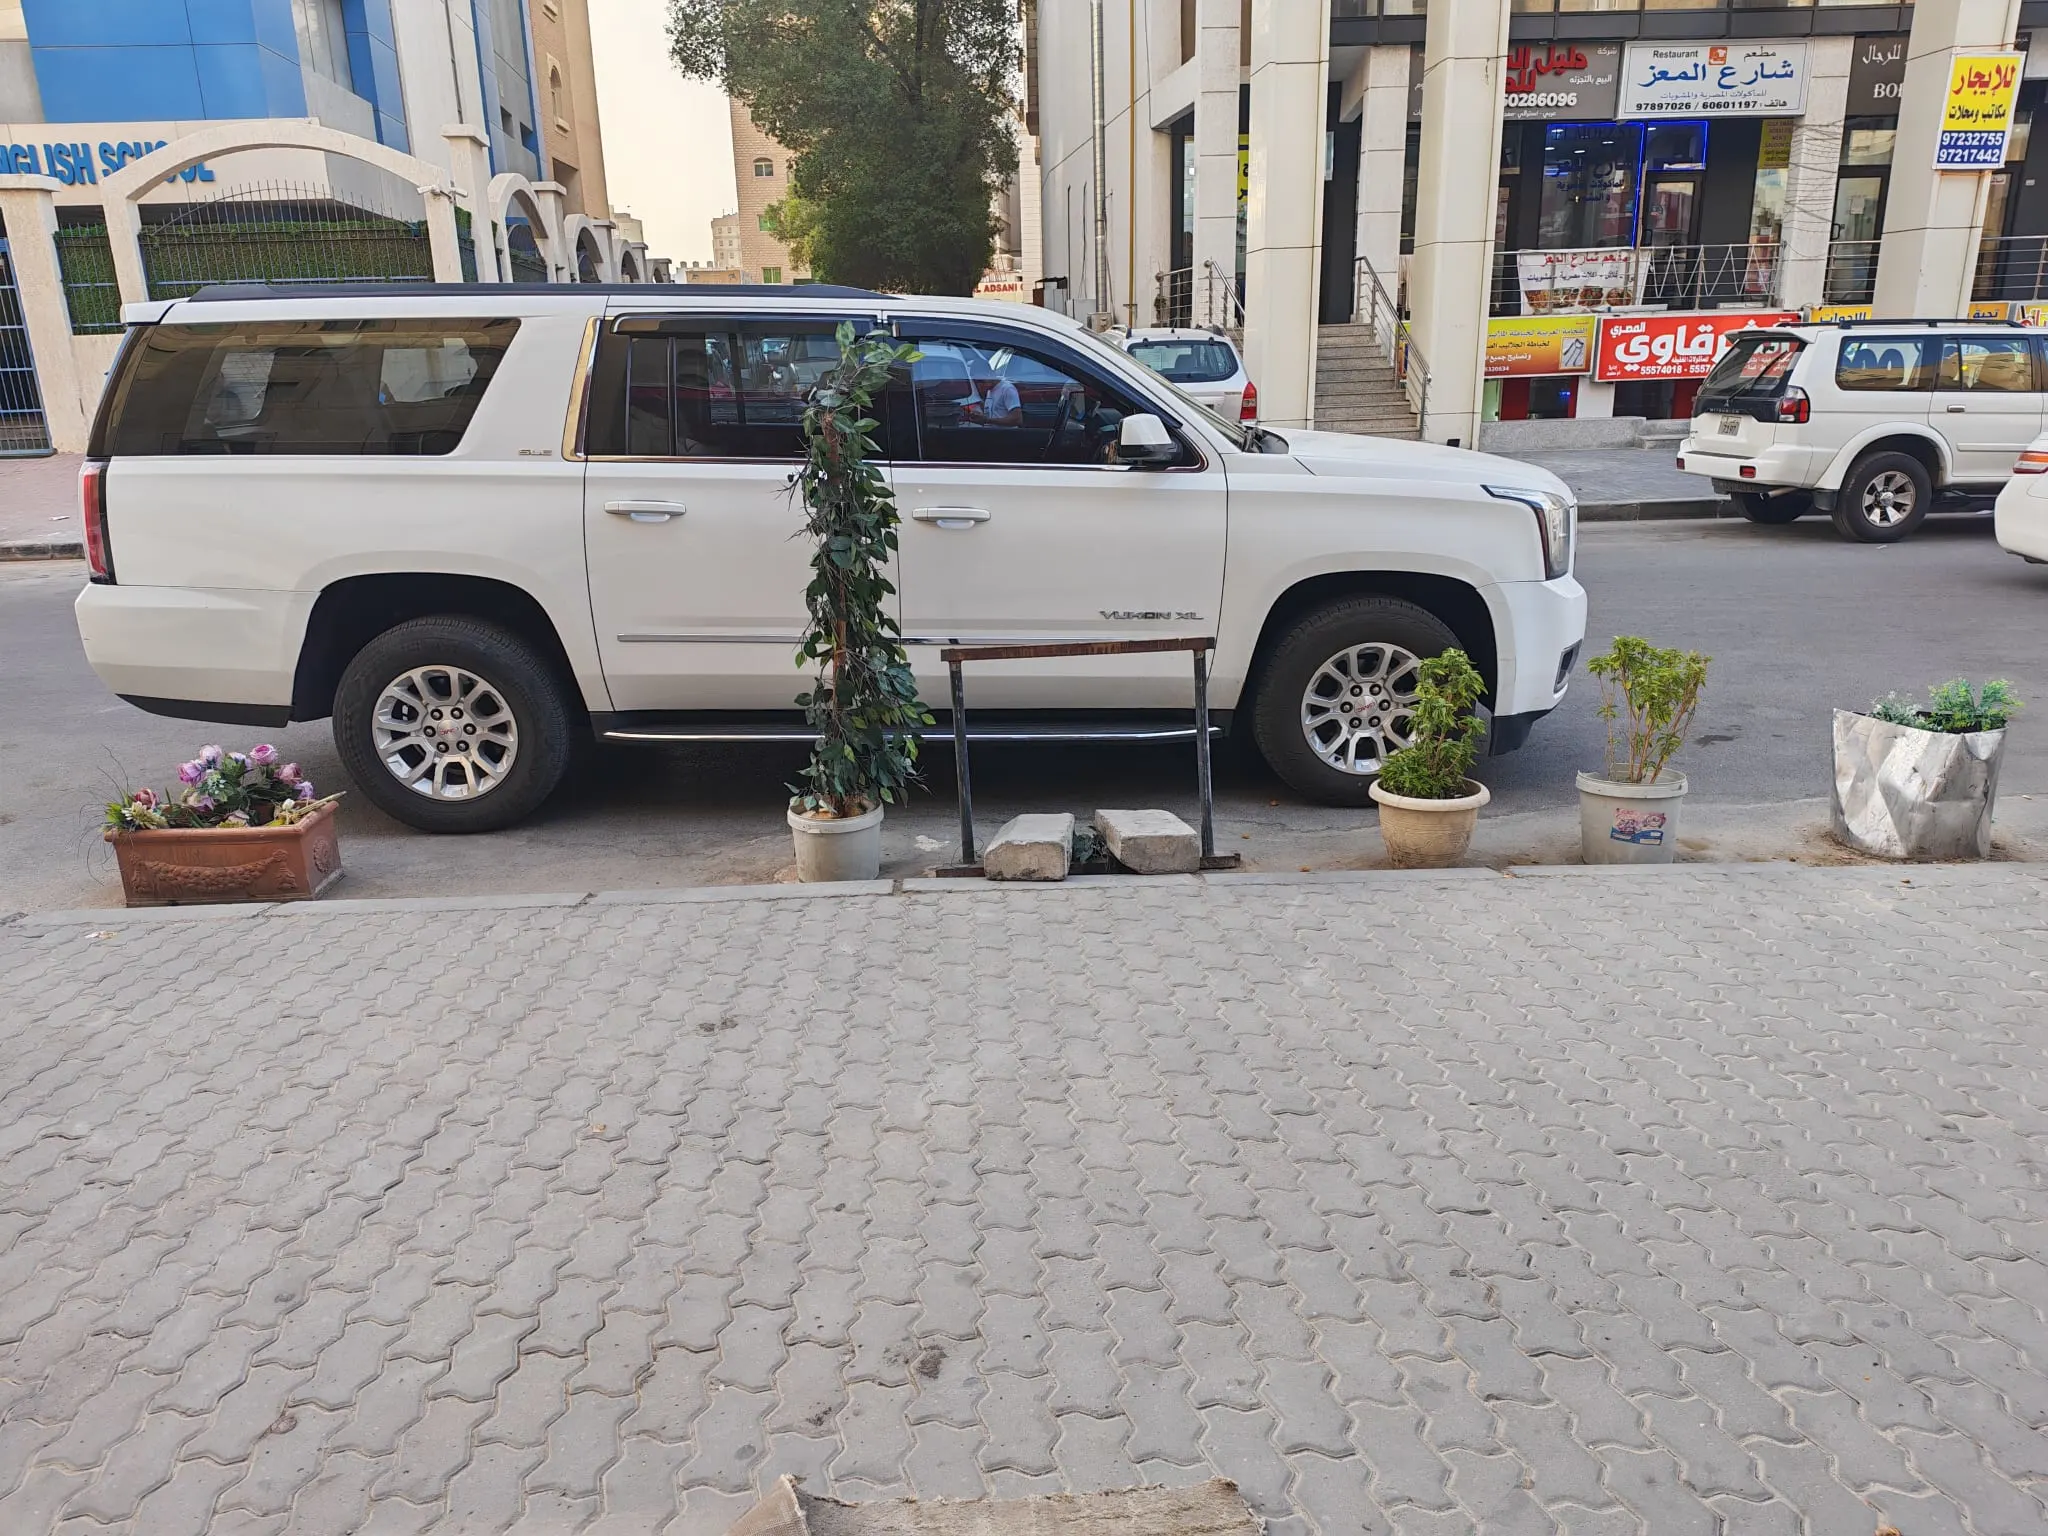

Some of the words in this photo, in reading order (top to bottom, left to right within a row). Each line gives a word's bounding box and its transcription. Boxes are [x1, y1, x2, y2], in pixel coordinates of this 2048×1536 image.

[1597, 47, 1618, 55] شركة
[1653, 50, 1699, 59] Restaurant
[1743, 46, 1776, 61] مطعم
[1862, 43, 1902, 66] للرجال
[1594, 74, 1613, 85] البيع
[1637, 62, 1707, 87] المعز
[1717, 60, 1794, 89] شارع
[1952, 63, 2016, 96] للإيجار
[1700, 91, 1728, 99] المصرية
[1636, 102, 1691, 111] 97897026
[1702, 101, 1758, 109] 60601197
[1948, 104, 1979, 123] ومحلات
[1982, 104, 2006, 123] مكاتب
[1942, 132, 2003, 146] 97232755
[1939, 149, 2000, 162] 97217442
[983, 283, 1018, 293] ADSANI
[1610, 321, 1646, 338] المصري
[1640, 366, 1682, 375] 55574018
[1100, 610, 1172, 620] YUKON
[1175, 611, 1204, 620] XL
